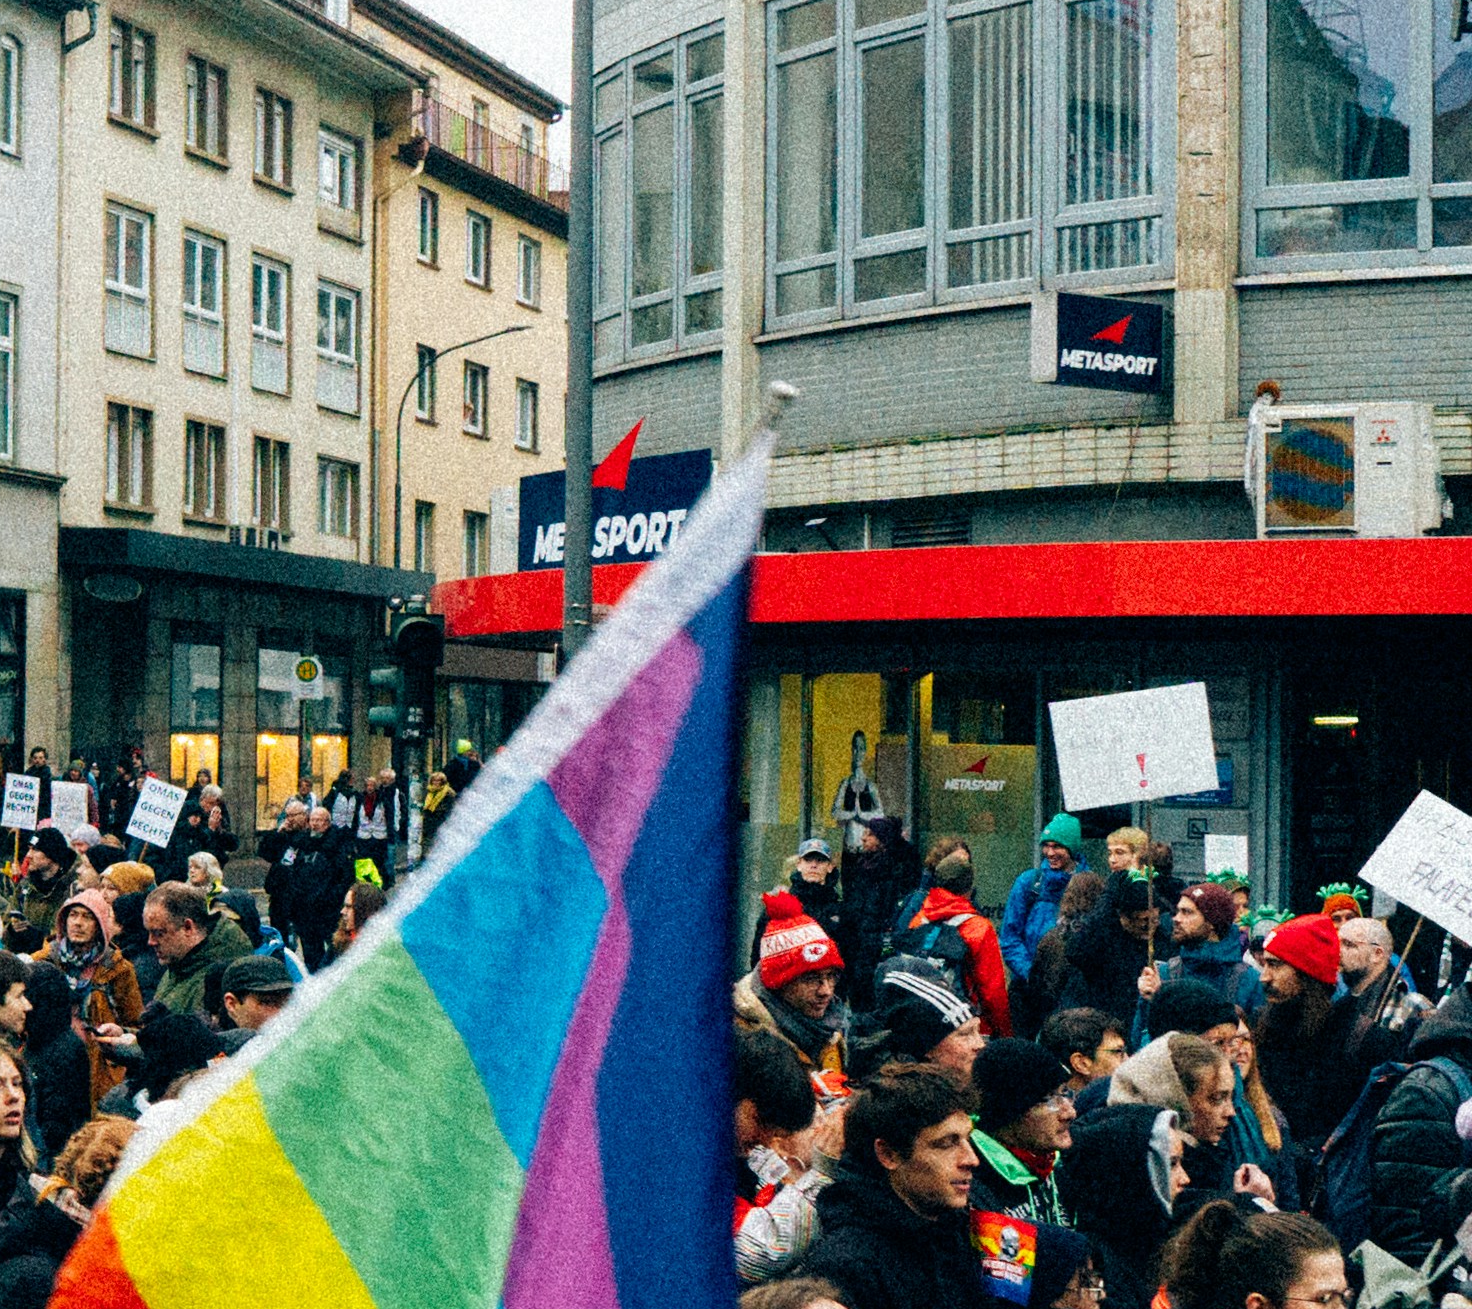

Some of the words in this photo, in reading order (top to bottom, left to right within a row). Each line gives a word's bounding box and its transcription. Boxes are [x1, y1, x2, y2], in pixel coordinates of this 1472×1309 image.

[1060, 346, 1158, 376] METASPORT
[532, 508, 688, 565] MESPORT
[148, 783, 180, 801] OMAS
[943, 777, 1006, 793] METASPORT
[9, 790, 35, 802] GEGEN
[6, 802, 36, 814] RECHTS
[140, 801, 176, 821] GEGEN
[131, 819, 171, 841] RECHTS
